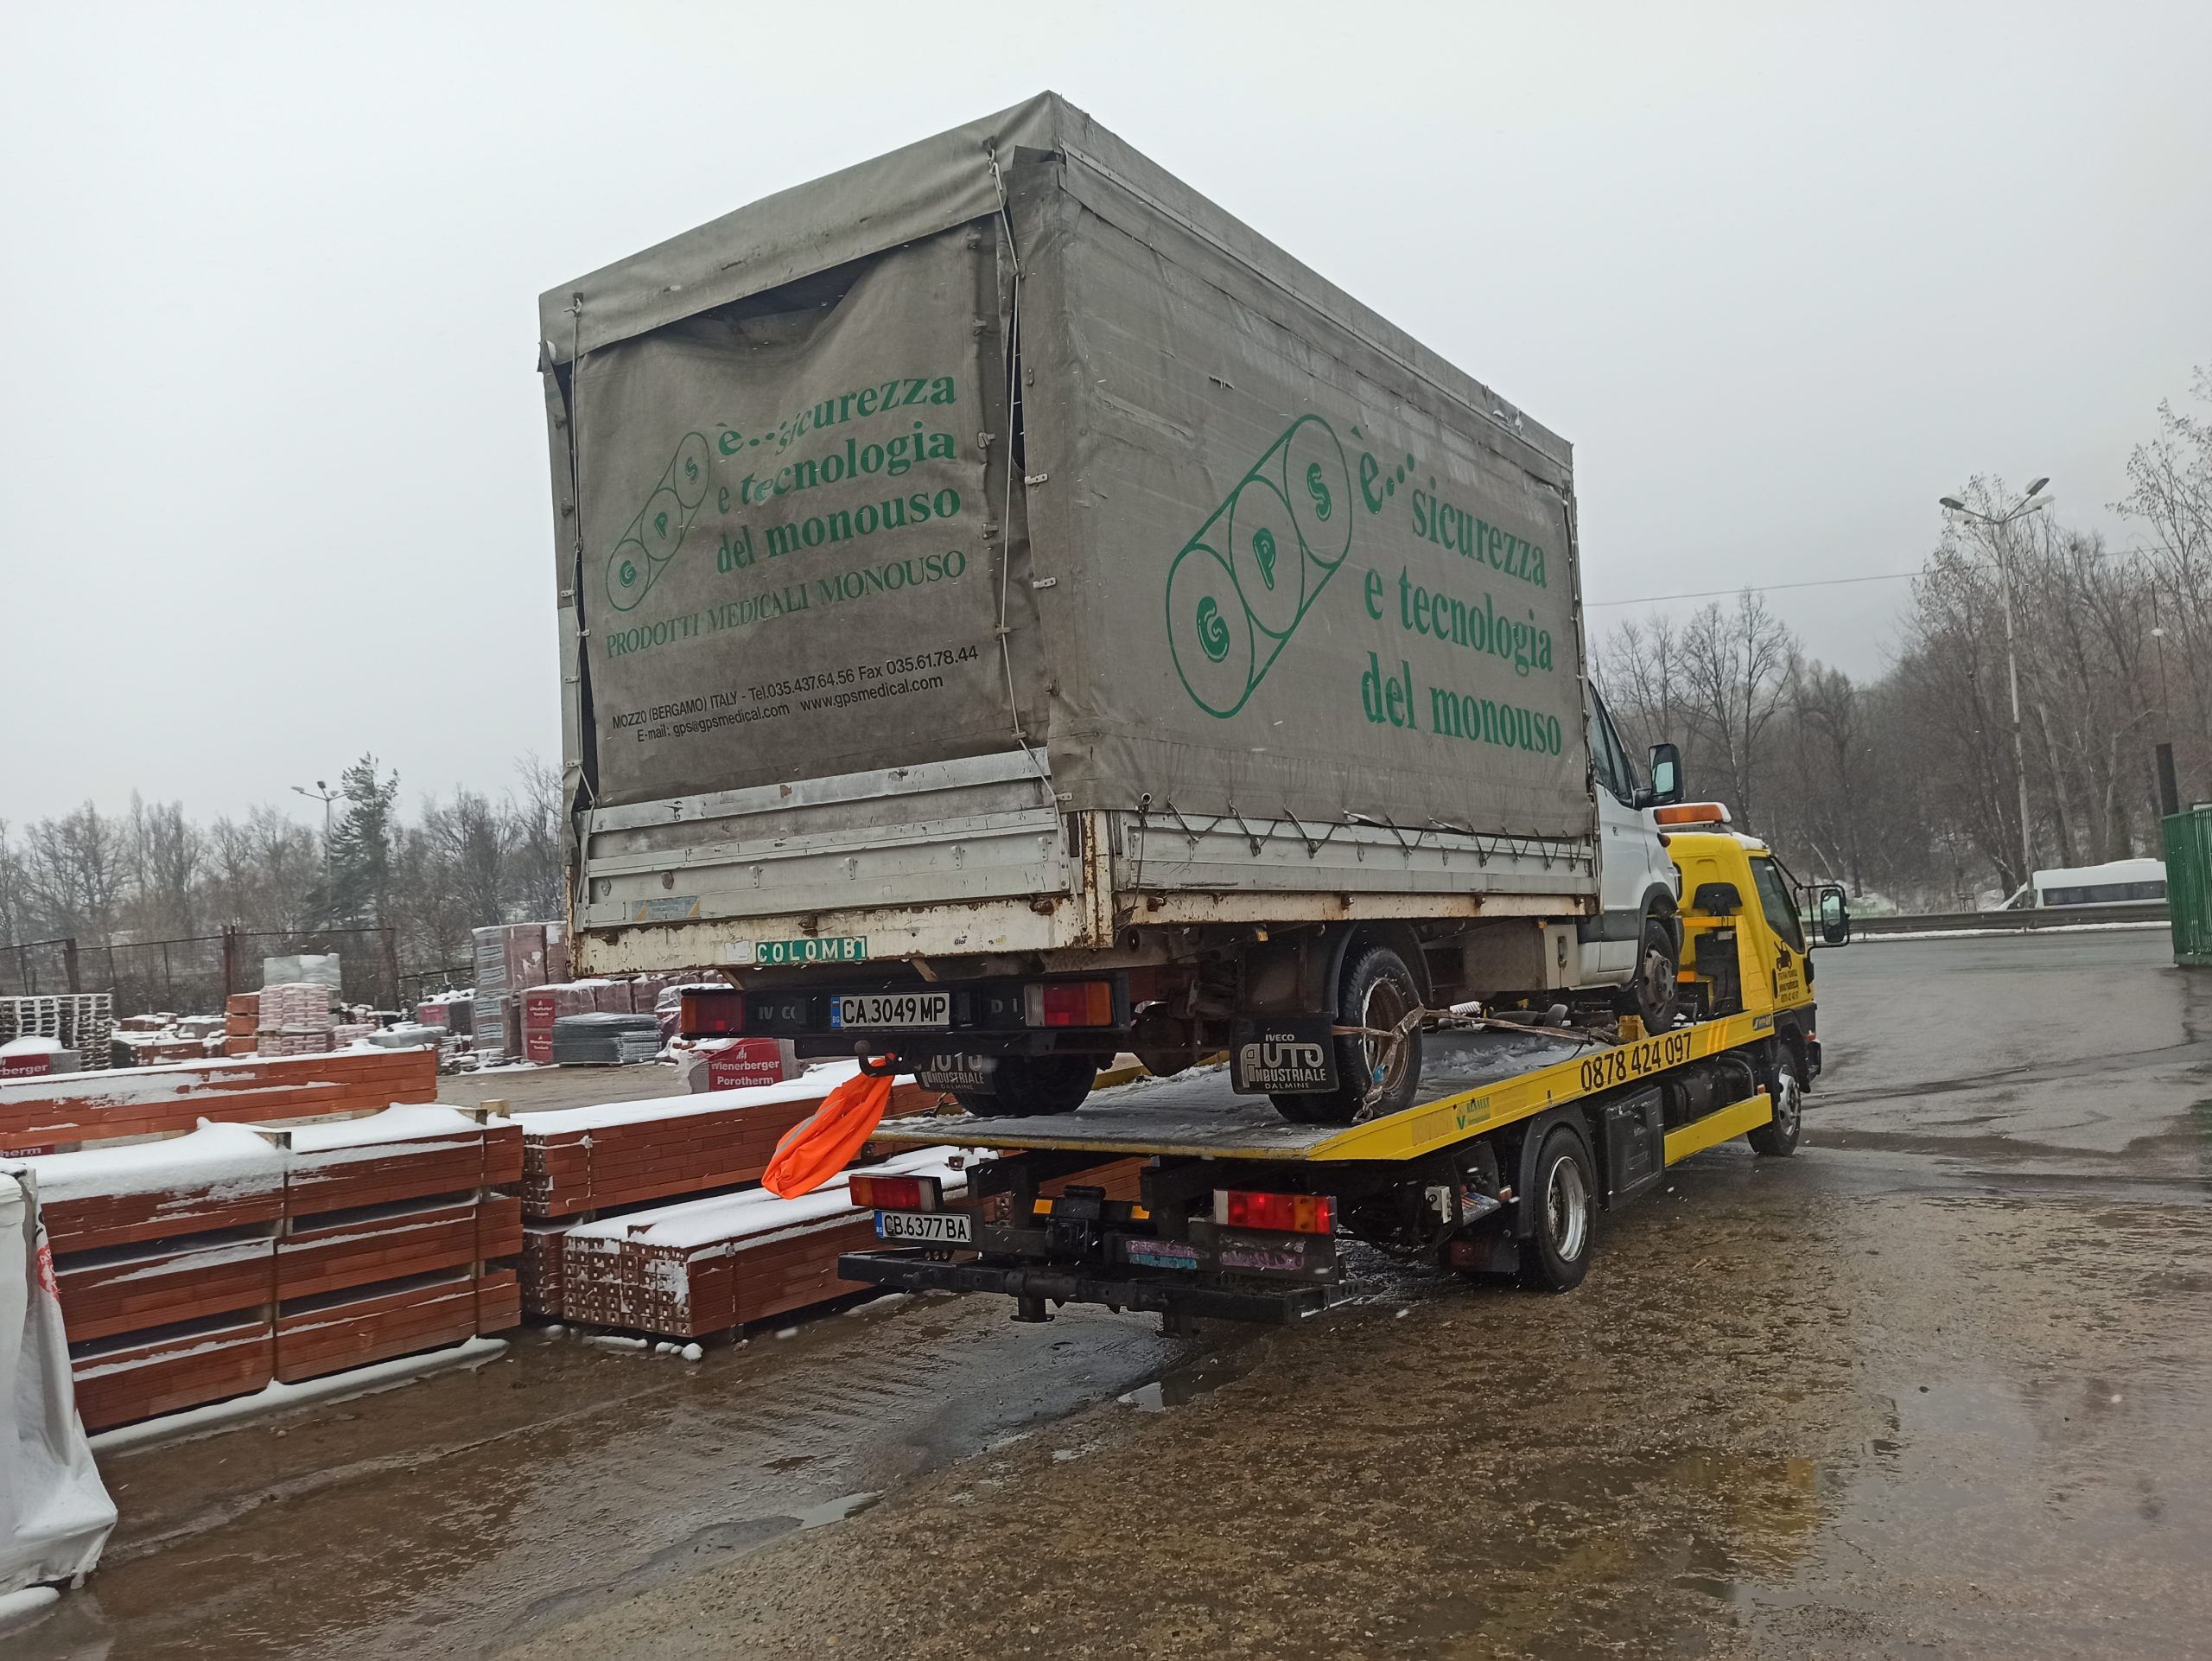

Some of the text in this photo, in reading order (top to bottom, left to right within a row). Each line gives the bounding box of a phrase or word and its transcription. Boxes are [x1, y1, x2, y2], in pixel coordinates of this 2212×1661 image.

[775, 375, 957, 456] sicurezza
[718, 421, 957, 514] e tecnologia
[717, 487, 961, 574] del monouso
[1253, 527, 1275, 591] P
[1412, 476, 1547, 589] sicurezza
[607, 550, 966, 659] PRODOTTI MEDICALI MONOUSO
[1364, 565, 1554, 677] e tecnologia
[613, 710, 647, 729] MOZZO
[649, 697, 707, 722] (BERGAMO)
[710, 691, 739, 709] ITALY
[748, 669, 855, 702] Tel.035.437.64.56
[858, 665, 883, 680] Fax
[887, 646, 978, 675] 035.61.78.44
[637, 676, 944, 742] E-mail: gps@gpsmedical.com www.gpsmedical.com
[1361, 651, 1561, 756] del monouso
[1240, 1043, 1324, 1088] AUTO
[1248, 1066, 1326, 1082] INDUSTRIALE
[1265, 1034, 1295, 1042] IVECO
[1580, 1032, 1691, 1091] 0878 424 097
[717, 1076, 773, 1085] Porotherm
